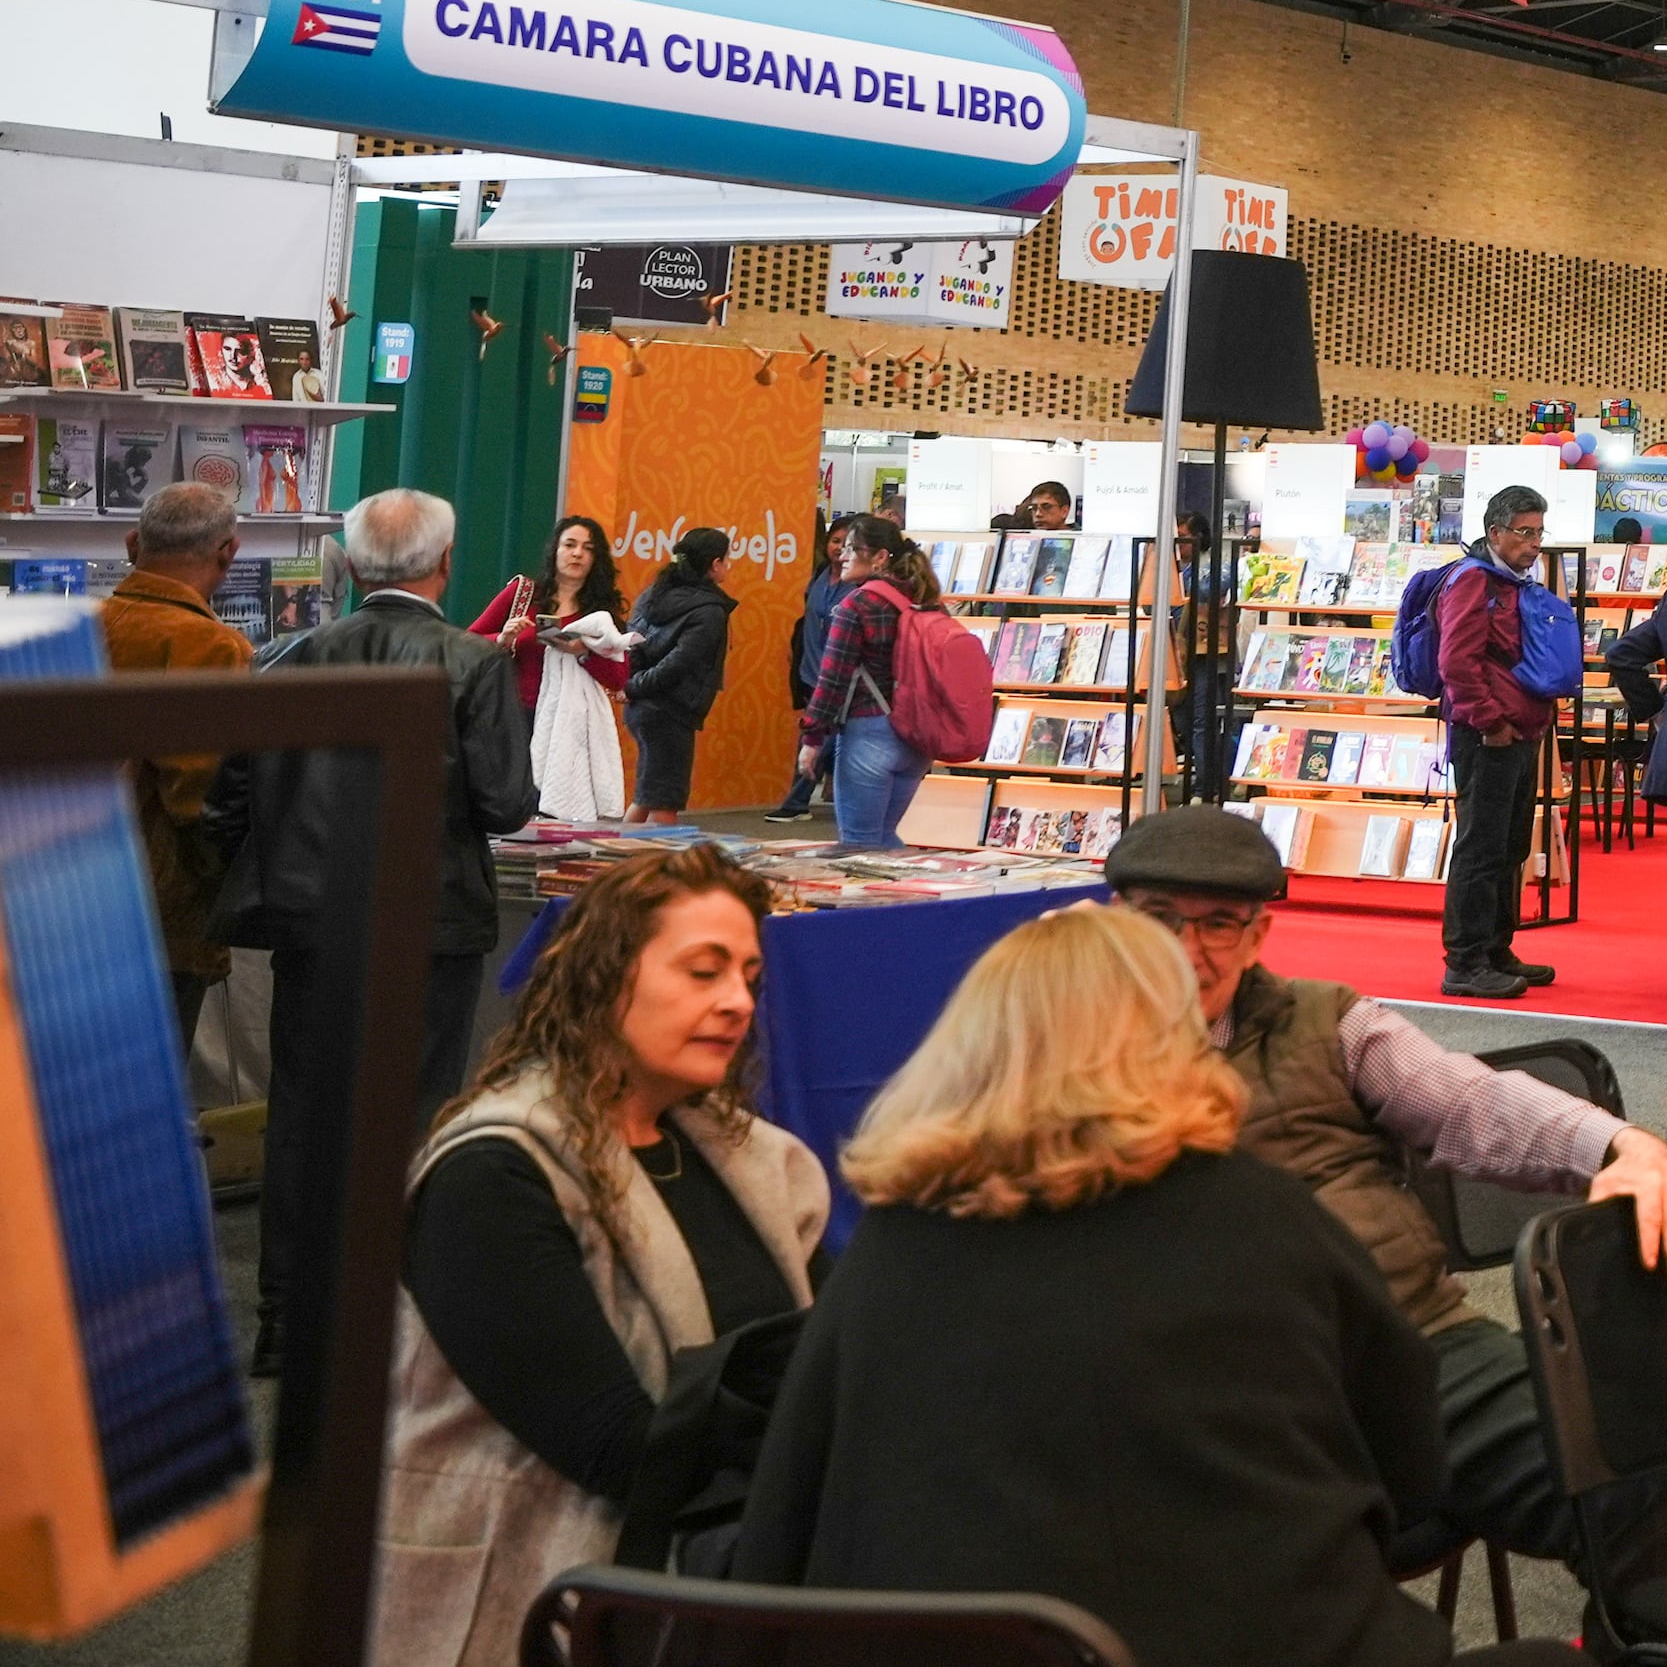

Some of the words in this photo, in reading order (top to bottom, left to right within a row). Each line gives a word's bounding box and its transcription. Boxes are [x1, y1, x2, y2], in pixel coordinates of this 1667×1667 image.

[663, 34, 842, 99] CUBANA
[853, 67, 926, 113] DEL
[937, 80, 1045, 131] LIBRO
[659, 250, 692, 263] PLAN
[651, 262, 696, 276] LECTOR
[640, 274, 708, 292] URBANO
[840, 271, 907, 284] JUGANDO
[914, 273, 924, 284] Y
[842, 285, 920, 299] EDUCANDO
[939, 275, 990, 295] JUGANDO
[996, 285, 1004, 296] Y
[941, 289, 1000, 310] EDUCANDO
[381, 326, 410, 338] Stand:
[384, 338, 405, 348] 1919
[582, 370, 608, 381] Stand:
[583, 382, 604, 391] 1920
[1597, 473, 1625, 482] ENTAS
[1275, 488, 1302, 498] Plutón
